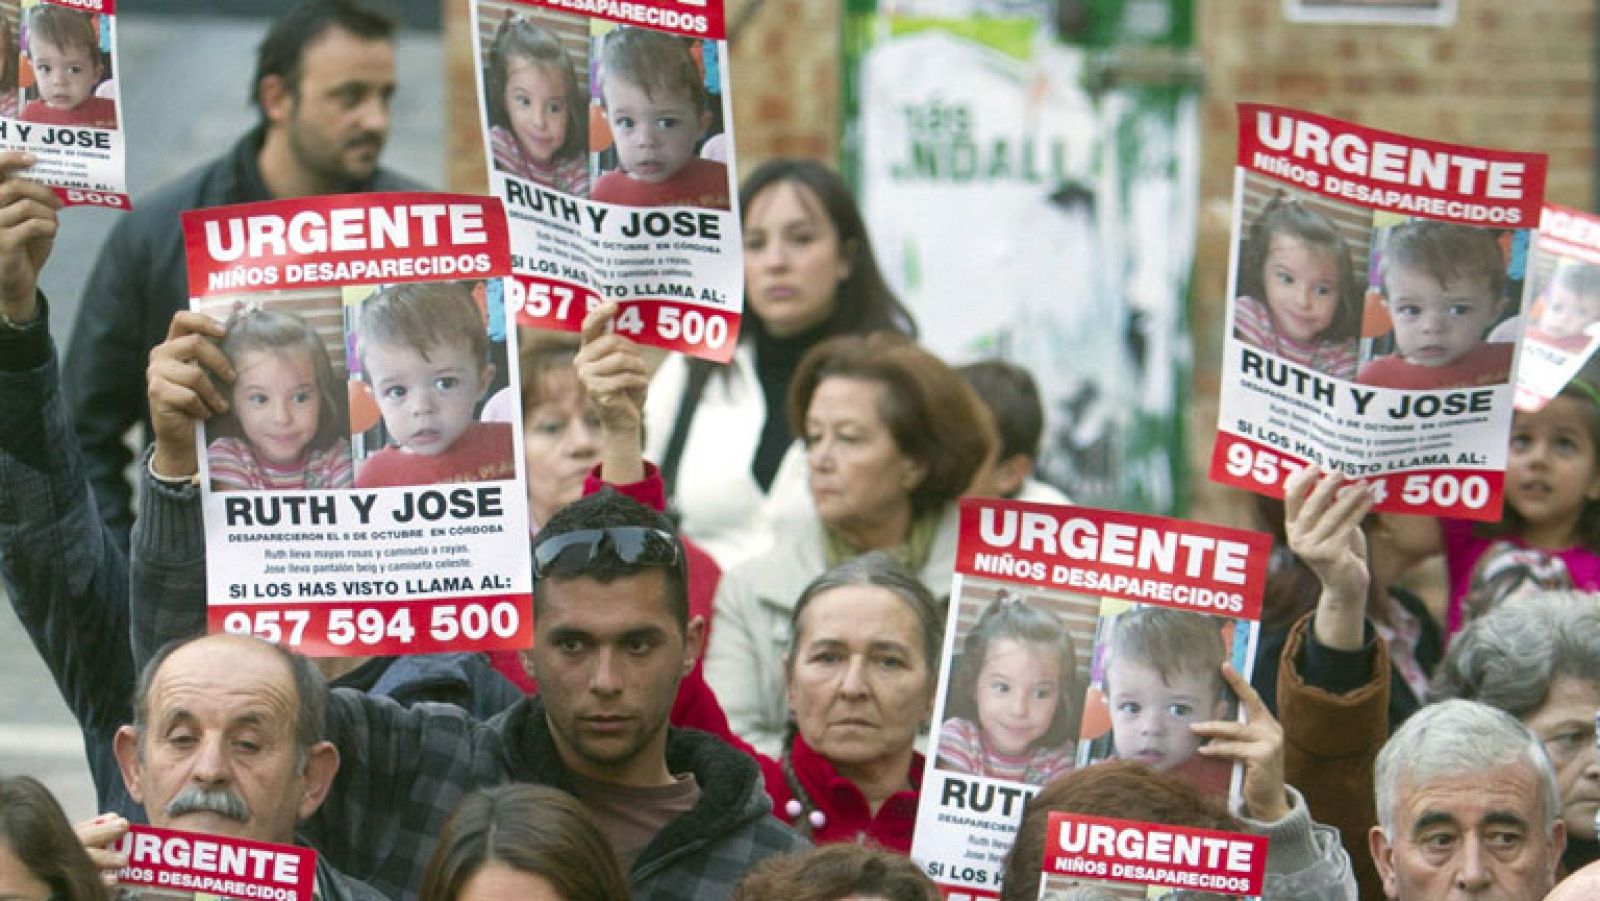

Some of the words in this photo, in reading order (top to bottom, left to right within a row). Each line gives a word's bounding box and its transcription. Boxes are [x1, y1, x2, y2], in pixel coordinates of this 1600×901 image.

[547, 0, 708, 32] SAPARECIDOS
[16, 124, 31, 142] Y
[41, 128, 111, 149] JOSE
[1257, 111, 1525, 200] URGENTE
[1253, 151, 1320, 188] NIÑOS
[1324, 175, 1521, 224] DESAPARECIDOS
[504, 178, 581, 224] RUTH
[586, 206, 608, 233] Y
[621, 211, 721, 240] JOSE
[205, 204, 488, 262] URGENTE
[208, 265, 279, 290] NIÑOS
[285, 254, 491, 283] DESAPARECIDOS
[634, 283, 695, 298] LLAMA
[656, 306, 728, 349] 500
[1240, 348, 1336, 408] RUTH
[1351, 389, 1376, 415] Y
[1389, 389, 1494, 419] JOSE
[1258, 426, 1290, 449] LOS
[1387, 453, 1450, 469] LLAMA
[224, 495, 338, 527] RUTH
[350, 493, 377, 525] Y
[392, 487, 503, 523] JOSE
[1401, 474, 1489, 509] 500
[370, 528, 424, 540] OCTUBRE
[978, 506, 1249, 585] URGENTE
[229, 583, 247, 598] SI
[253, 582, 292, 598] LOS
[298, 581, 337, 597] HAS
[342, 579, 399, 597] VISTO
[405, 577, 474, 595] LLAMA
[480, 574, 512, 590] AL:
[973, 552, 1047, 581] NIÑOS
[1052, 563, 1244, 612] DESAPARECIDOS
[326, 607, 415, 644] 594
[430, 602, 519, 640] 500
[1058, 821, 1254, 873] URGENTE
[158, 871, 297, 901] DESAPARECIDOS
[928, 861, 945, 877] SI
[950, 864, 988, 884] LOS
[1055, 856, 1107, 875] NIÑOS
[1111, 861, 1249, 891] DESAPARECIDOS
